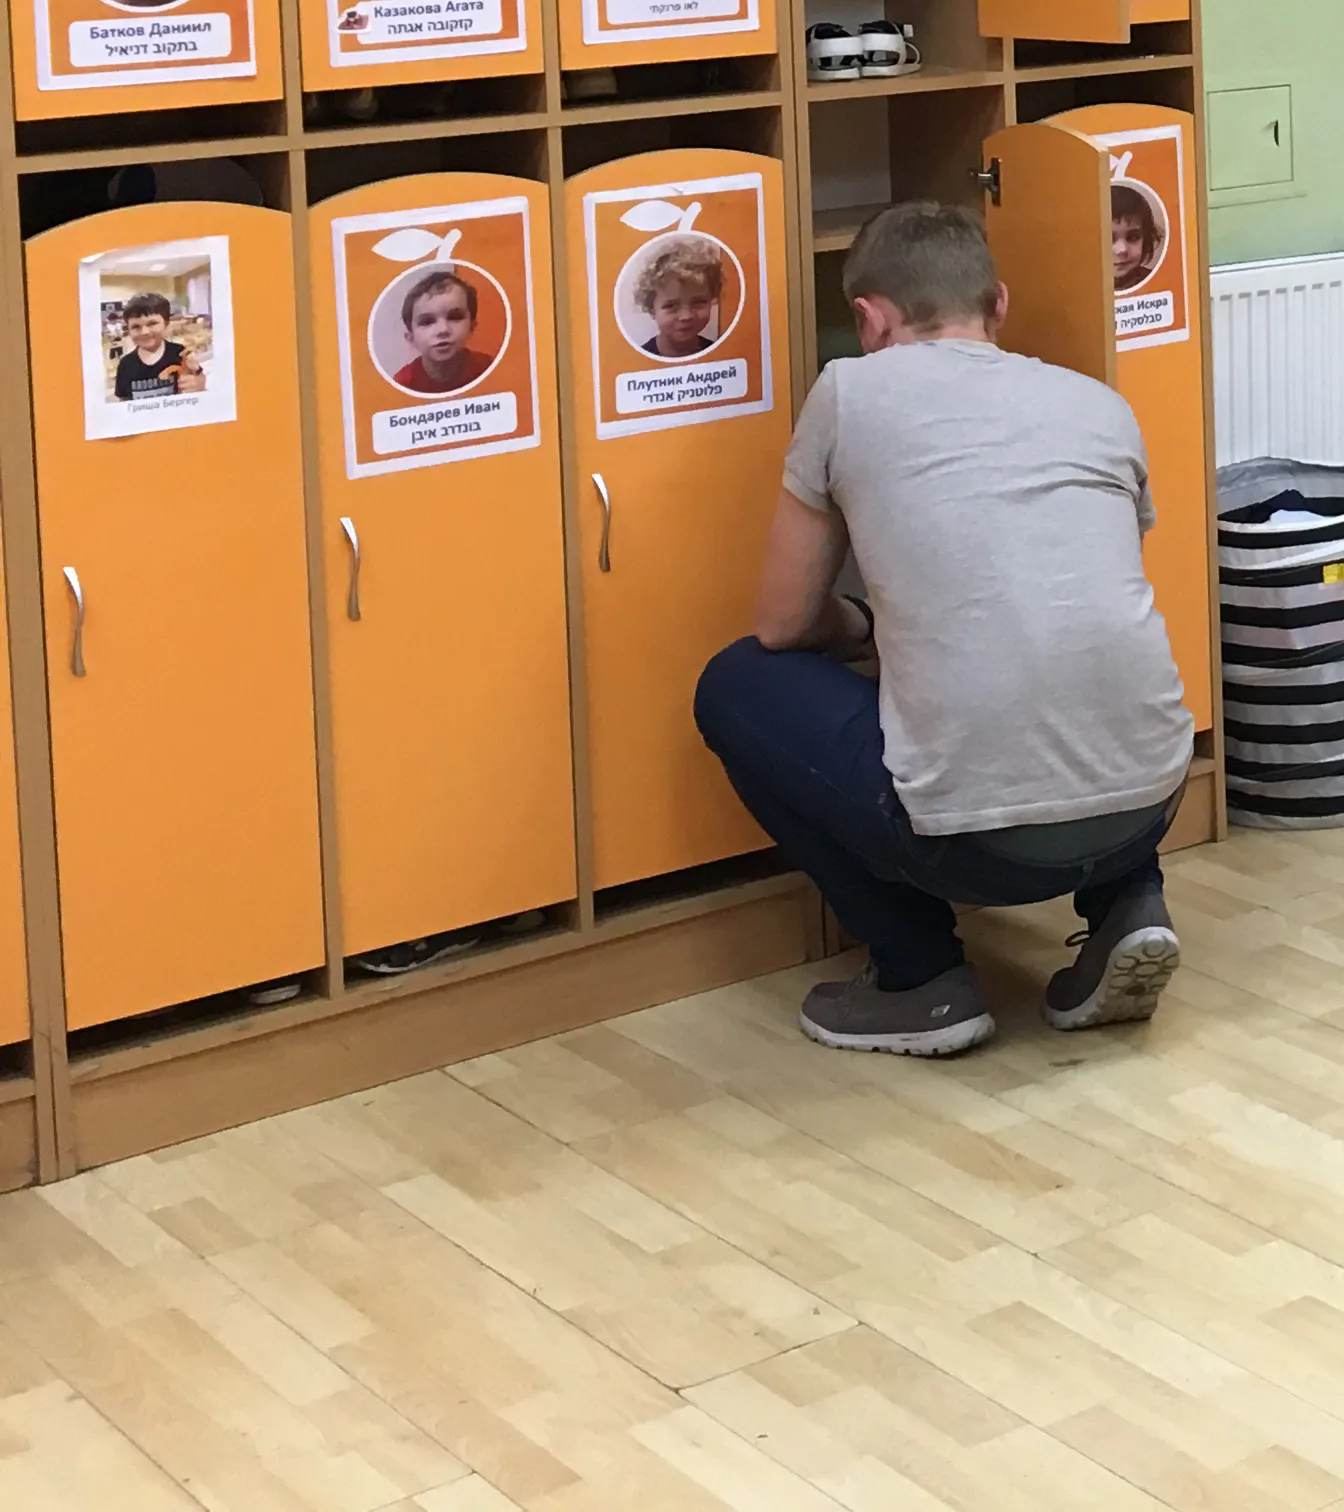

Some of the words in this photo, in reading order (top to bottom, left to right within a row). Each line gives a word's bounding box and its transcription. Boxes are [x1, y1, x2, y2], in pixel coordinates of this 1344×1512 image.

[374, 3, 441, 18] Казакова
[445, 0, 484, 13] Агата
[90, 25, 145, 39] Батков
[149, 21, 211, 38] Даниил
[387, 22, 423, 35] אגתה
[427, 18, 473, 32] קזקובה
[105, 43, 148, 56] דניאיל
[152, 40, 198, 55] בתקוב
[1136, 297, 1168, 310] Искра
[627, 375, 683, 391] Плутник
[686, 366, 737, 384] Андрей
[643, 392, 674, 403] אנדרי
[677, 383, 723, 402] פלוטניק
[127, 402, 160, 413] Гриша
[163, 396, 199, 408] Бергер
[389, 407, 461, 428] Бондарев
[464, 401, 501, 415] Иван
[411, 428, 437, 444] איבן
[440, 420, 481, 437] בונדרב
